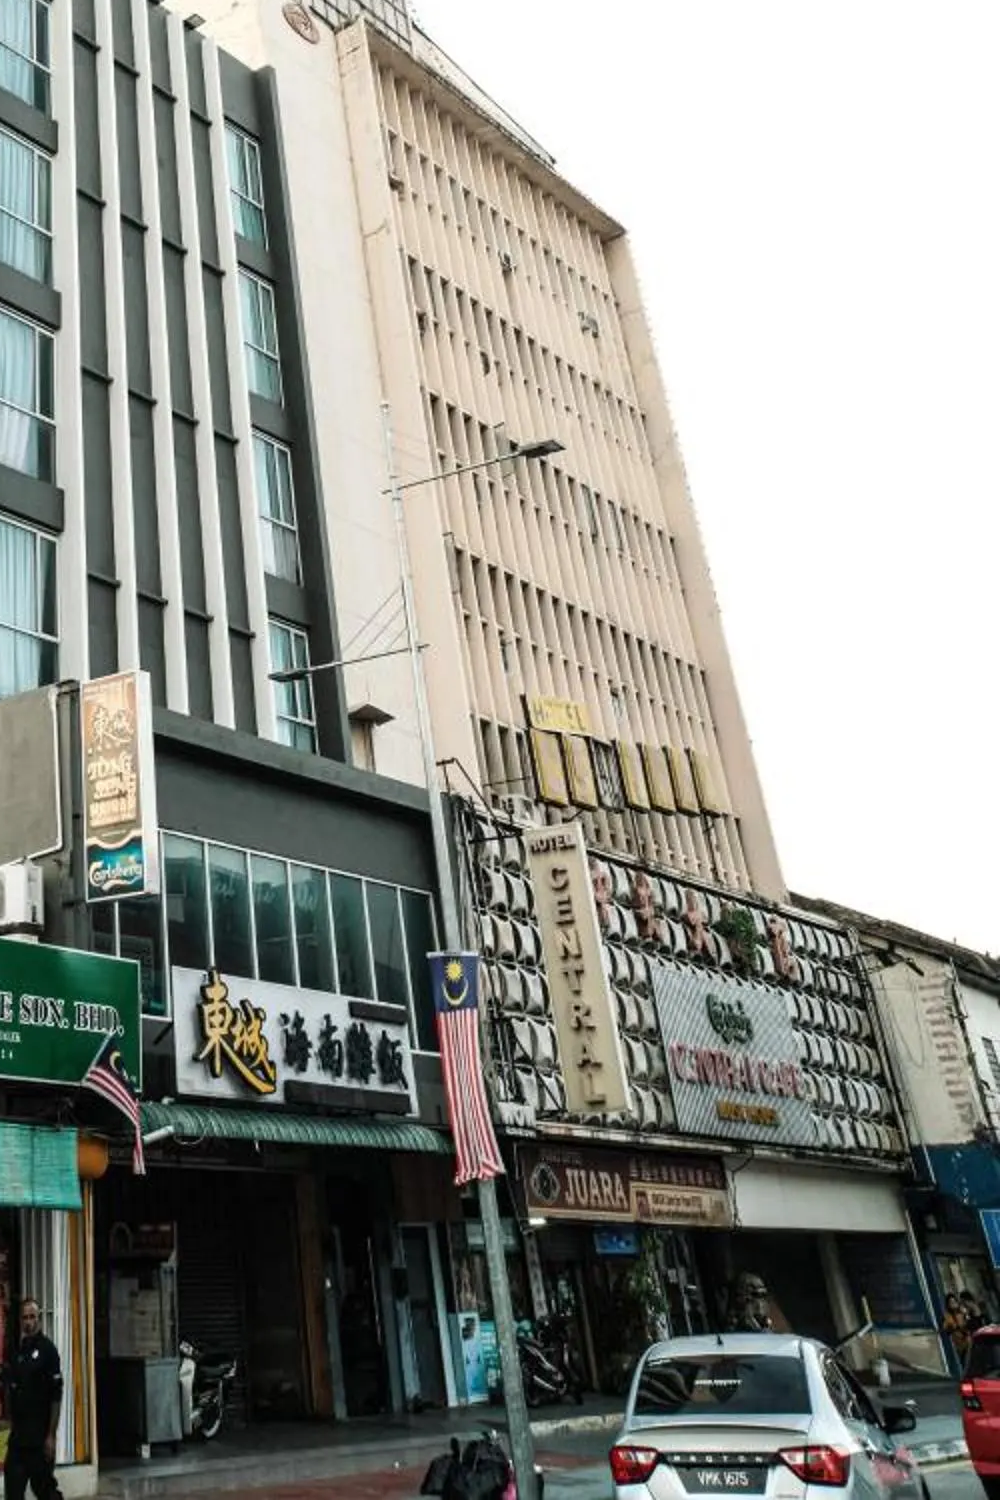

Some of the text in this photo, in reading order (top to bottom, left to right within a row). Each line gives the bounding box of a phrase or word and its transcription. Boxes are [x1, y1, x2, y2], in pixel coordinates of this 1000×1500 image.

[551, 867, 606, 1106] CENTRAL
[19, 994, 69, 1029] SDN.
[74, 1002, 125, 1037] BHD.
[192, 965, 277, 1095] 東城
[565, 1167, 628, 1209] JUARA
[672, 1454, 763, 1463] PROTON
